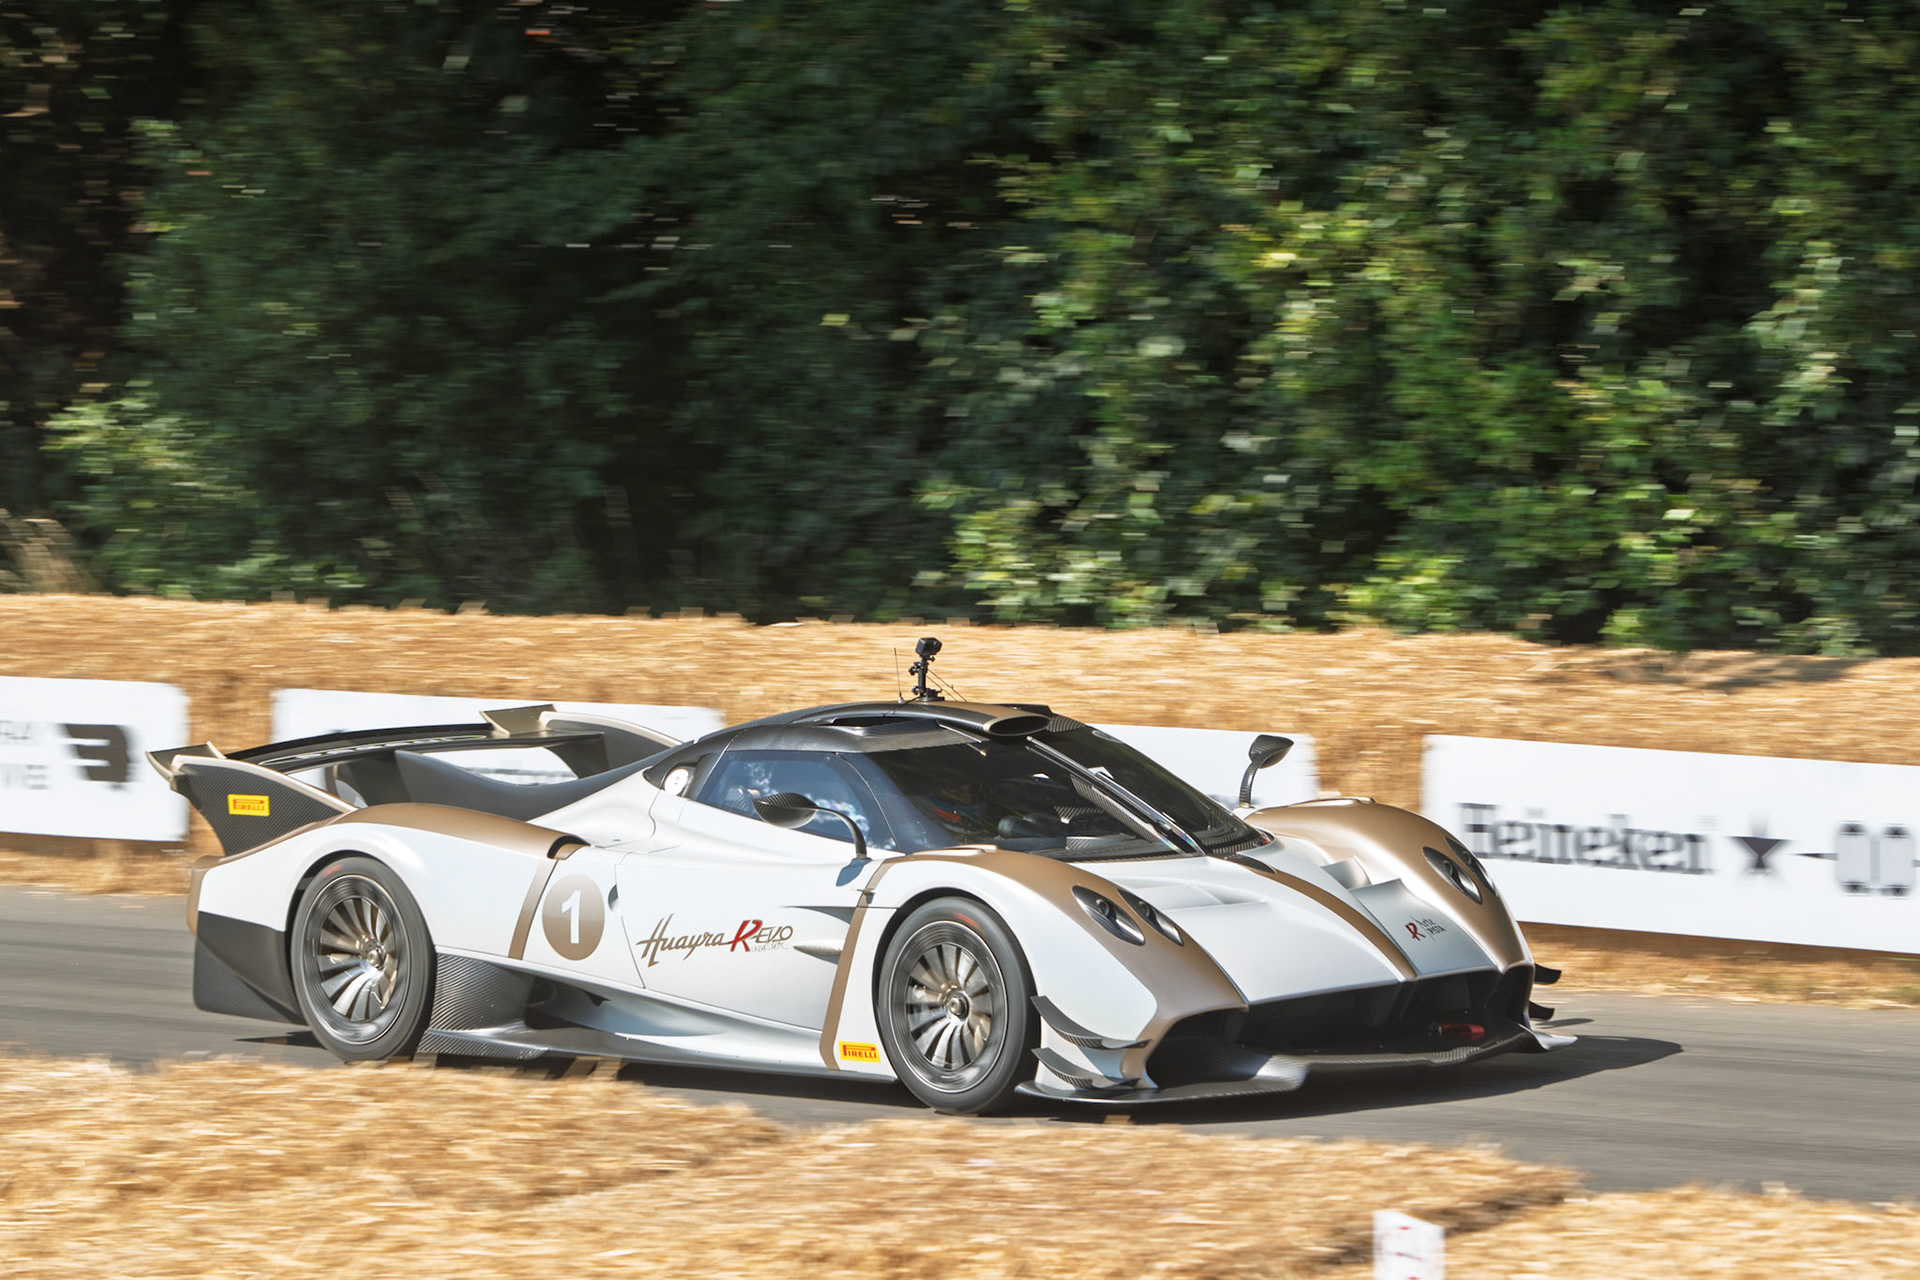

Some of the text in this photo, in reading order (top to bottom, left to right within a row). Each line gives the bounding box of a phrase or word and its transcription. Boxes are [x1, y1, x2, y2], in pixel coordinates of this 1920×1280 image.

[561, 889, 582, 944] 1
[635, 912, 730, 968] Huayra
[842, 1044, 877, 1058] PIRELLI
